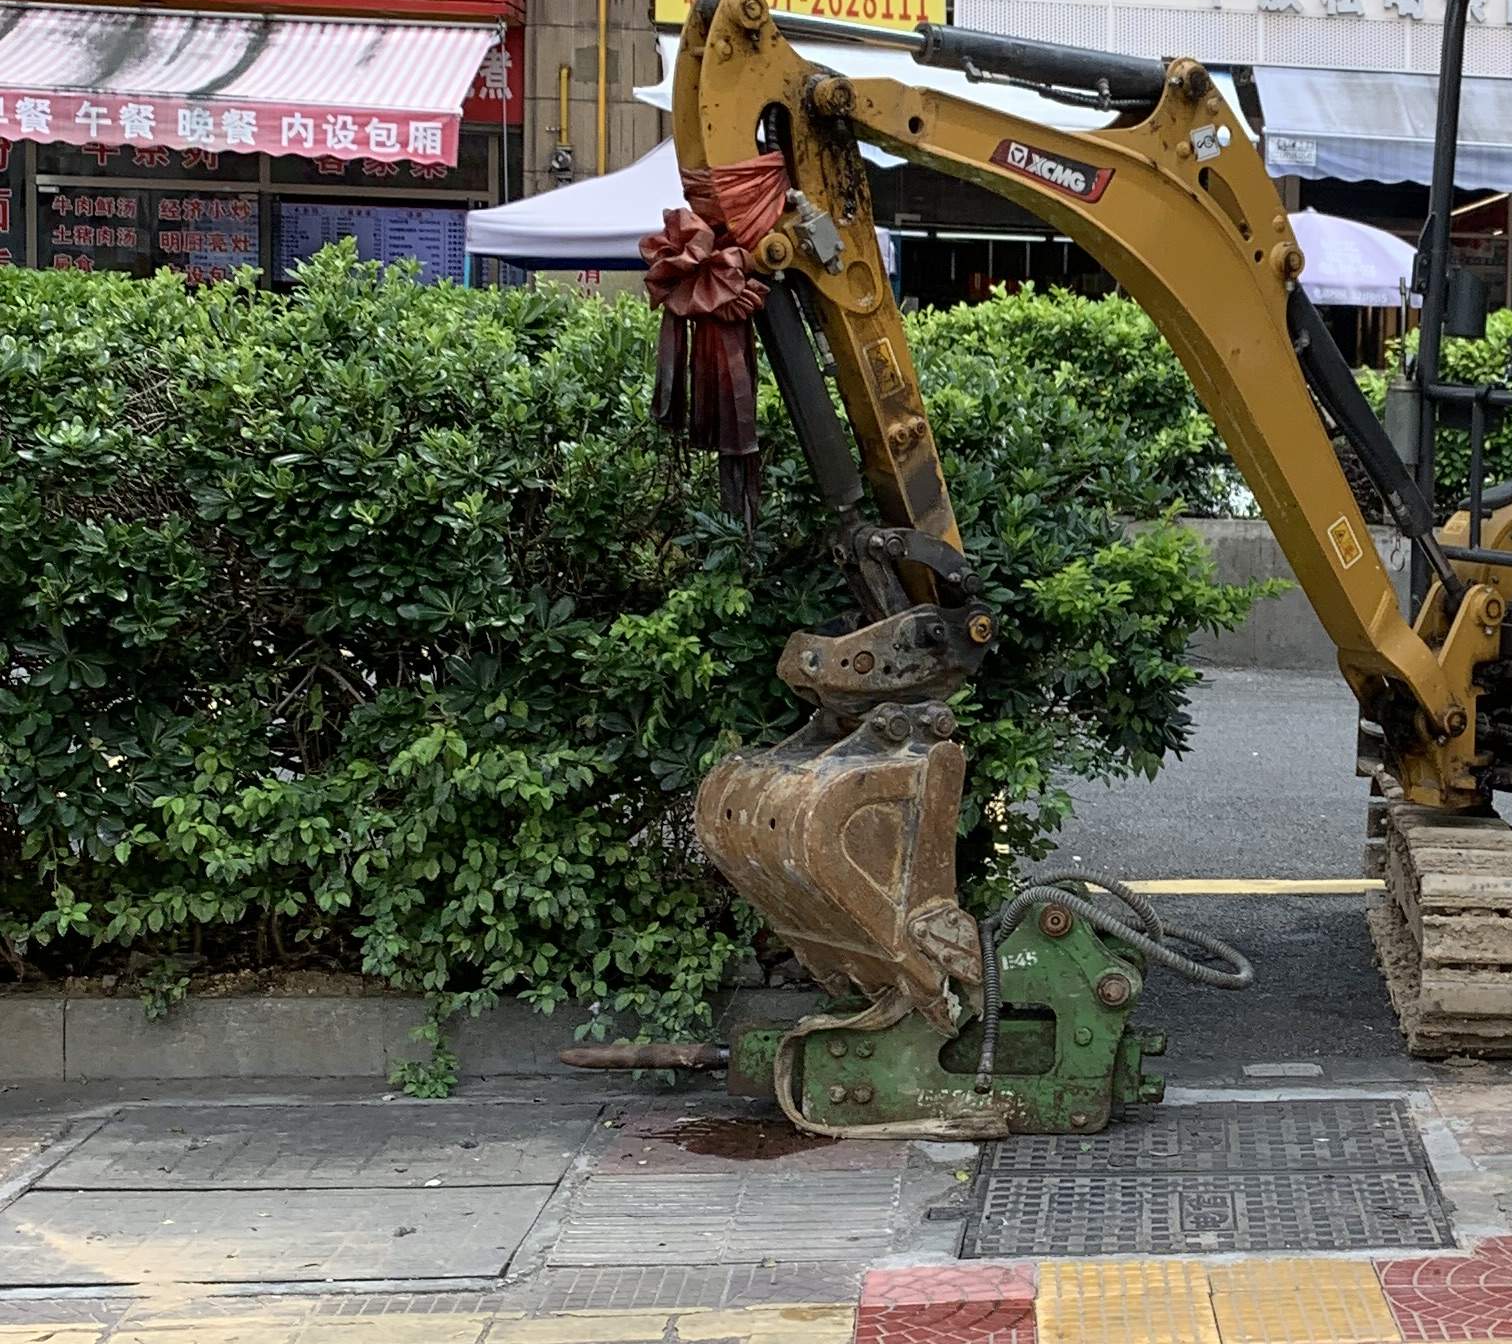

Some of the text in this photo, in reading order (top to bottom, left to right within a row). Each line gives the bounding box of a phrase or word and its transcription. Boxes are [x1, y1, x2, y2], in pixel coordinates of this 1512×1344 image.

[0, 96, 443, 155] 餐 午餐 晚餐 内设包厢
[1024, 152, 1086, 193] XCMG
[52, 195, 137, 219] 牛肉鲜汤
[159, 199, 251, 221] 经济小炒
[52, 225, 137, 248] 土猪肉汤
